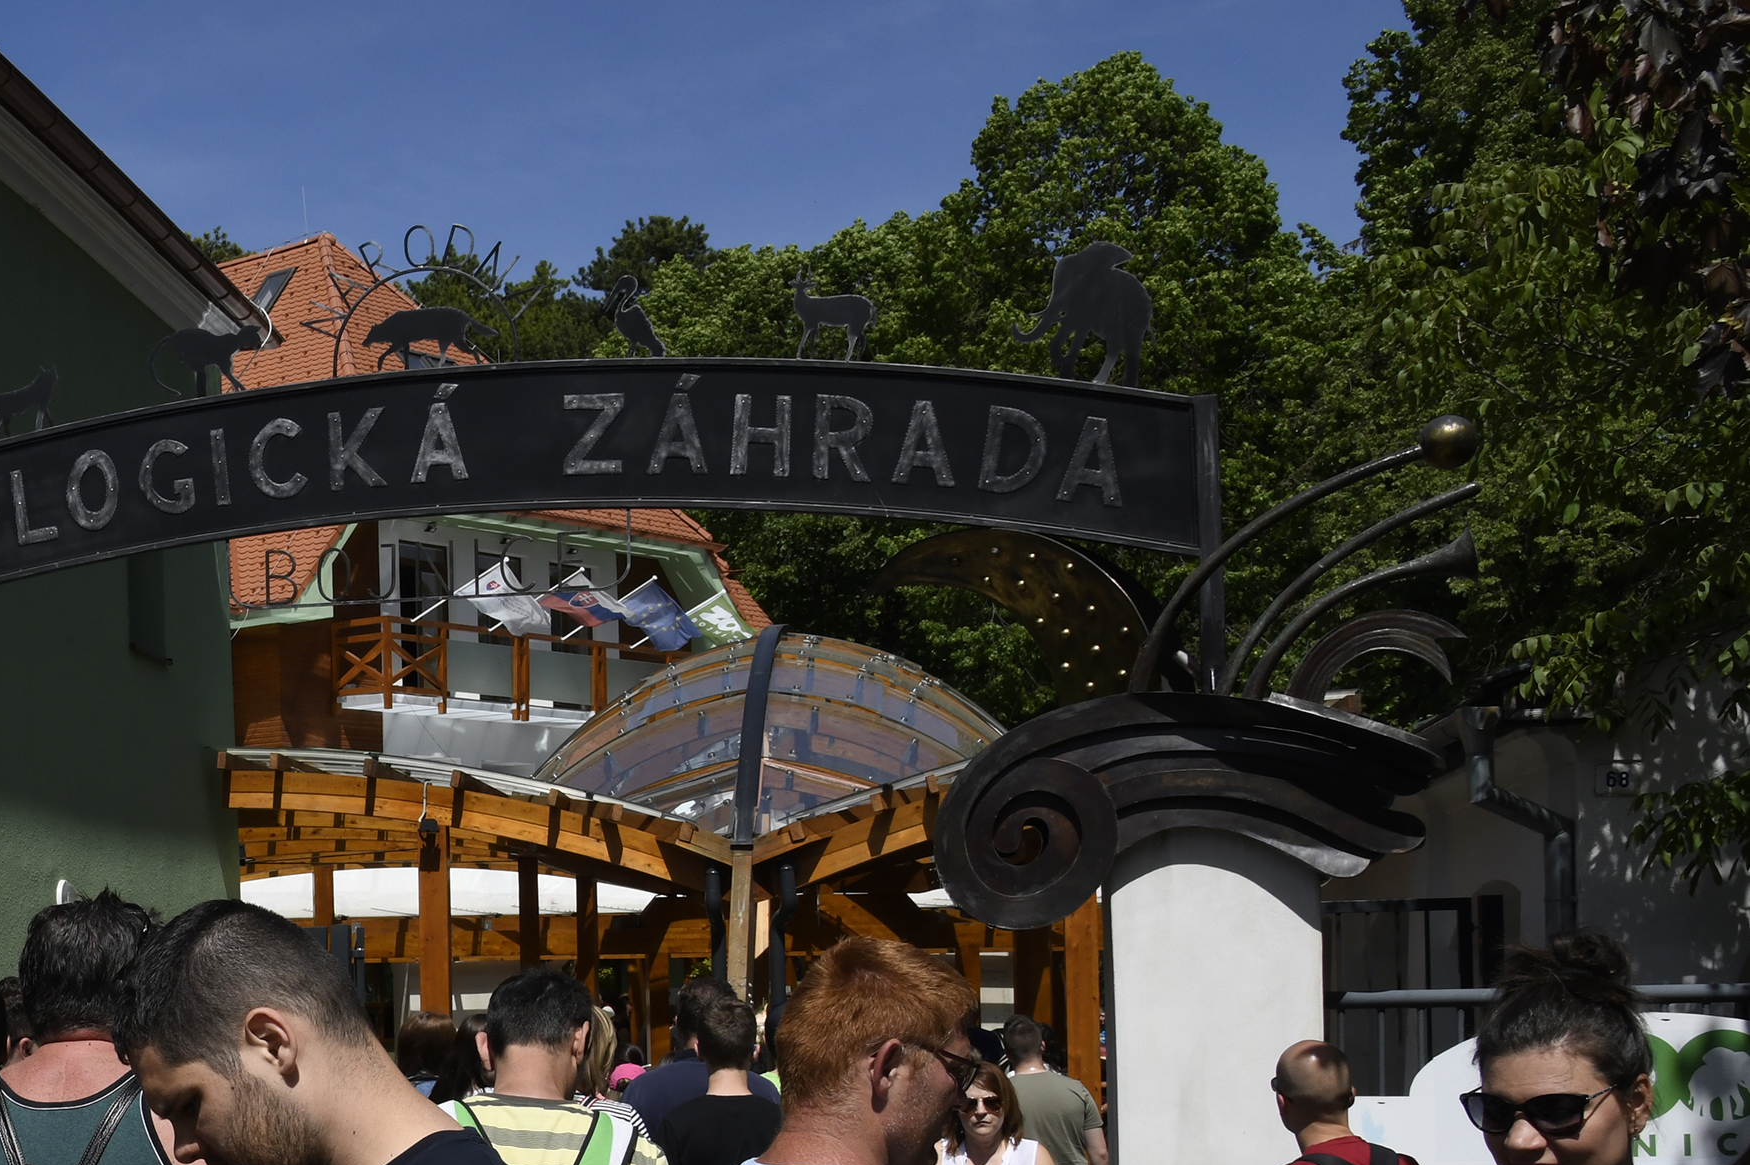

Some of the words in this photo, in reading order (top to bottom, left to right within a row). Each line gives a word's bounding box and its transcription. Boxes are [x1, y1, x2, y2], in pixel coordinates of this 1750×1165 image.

[563, 374, 1123, 508] ZÁHRADA
[265, 530, 591, 606] BOJNICE
[1606, 771, 1629, 788] 68
